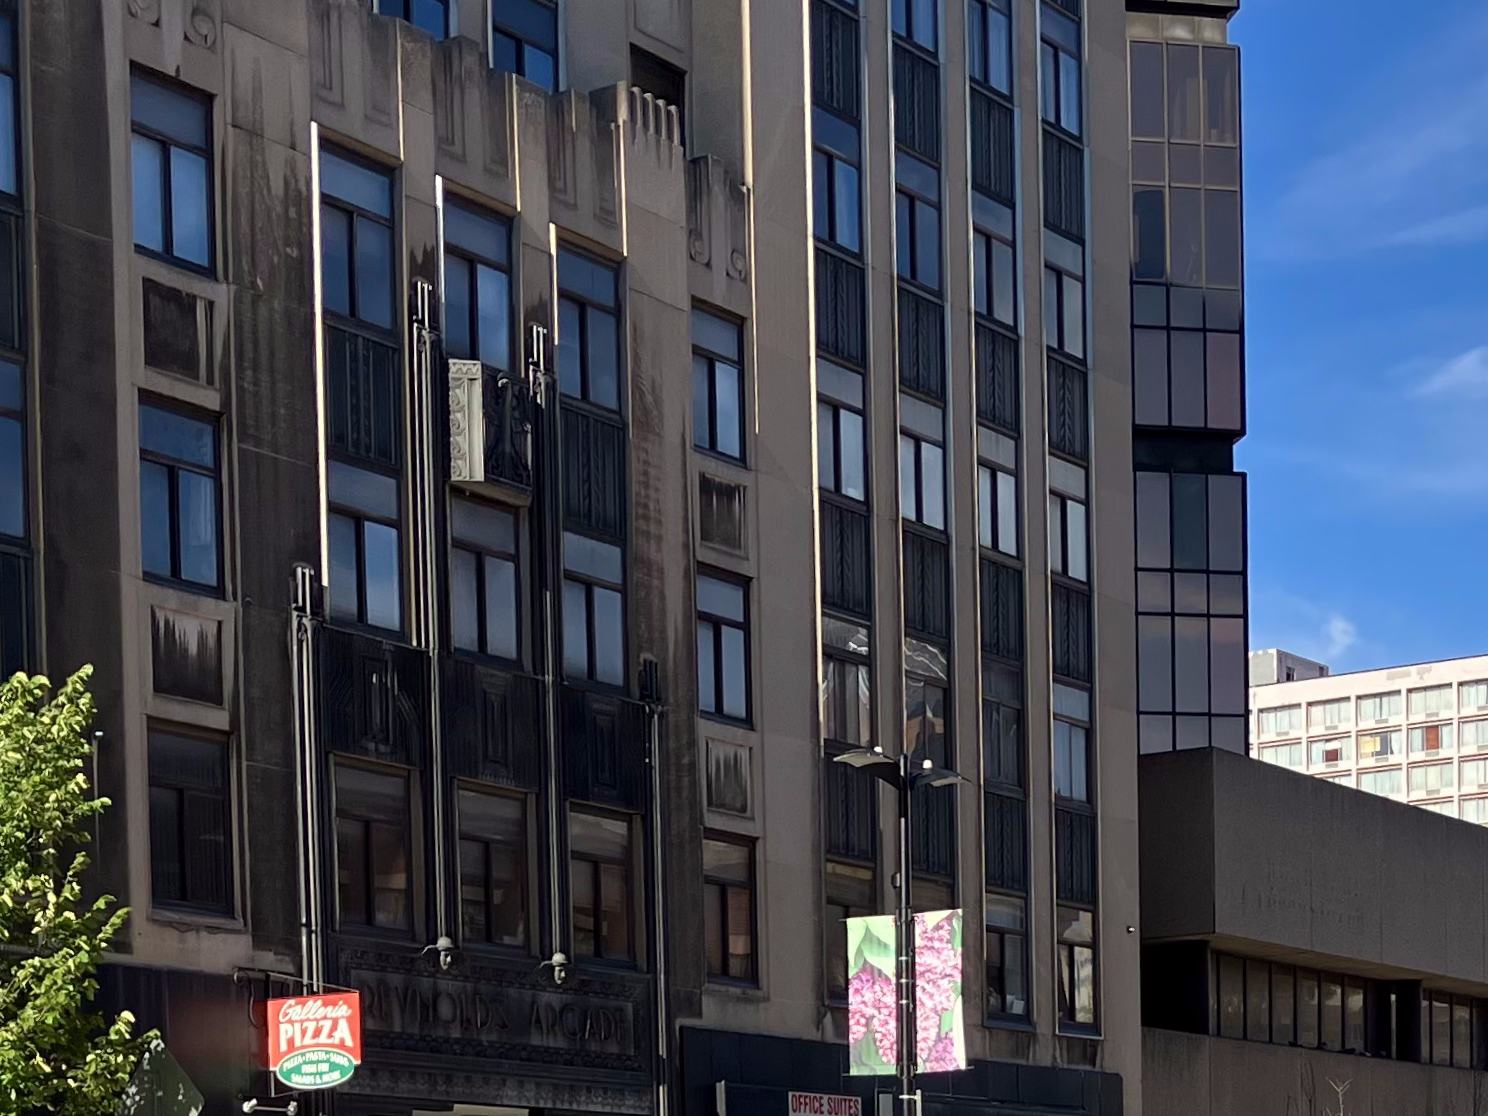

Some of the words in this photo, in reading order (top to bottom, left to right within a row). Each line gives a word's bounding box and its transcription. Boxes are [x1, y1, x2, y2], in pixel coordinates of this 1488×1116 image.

[279, 1000, 352, 1022] Galleria
[531, 997, 626, 1042] ARCADE
[279, 1018, 354, 1052] PIZZA
[791, 1094, 825, 1115] OFFICE
